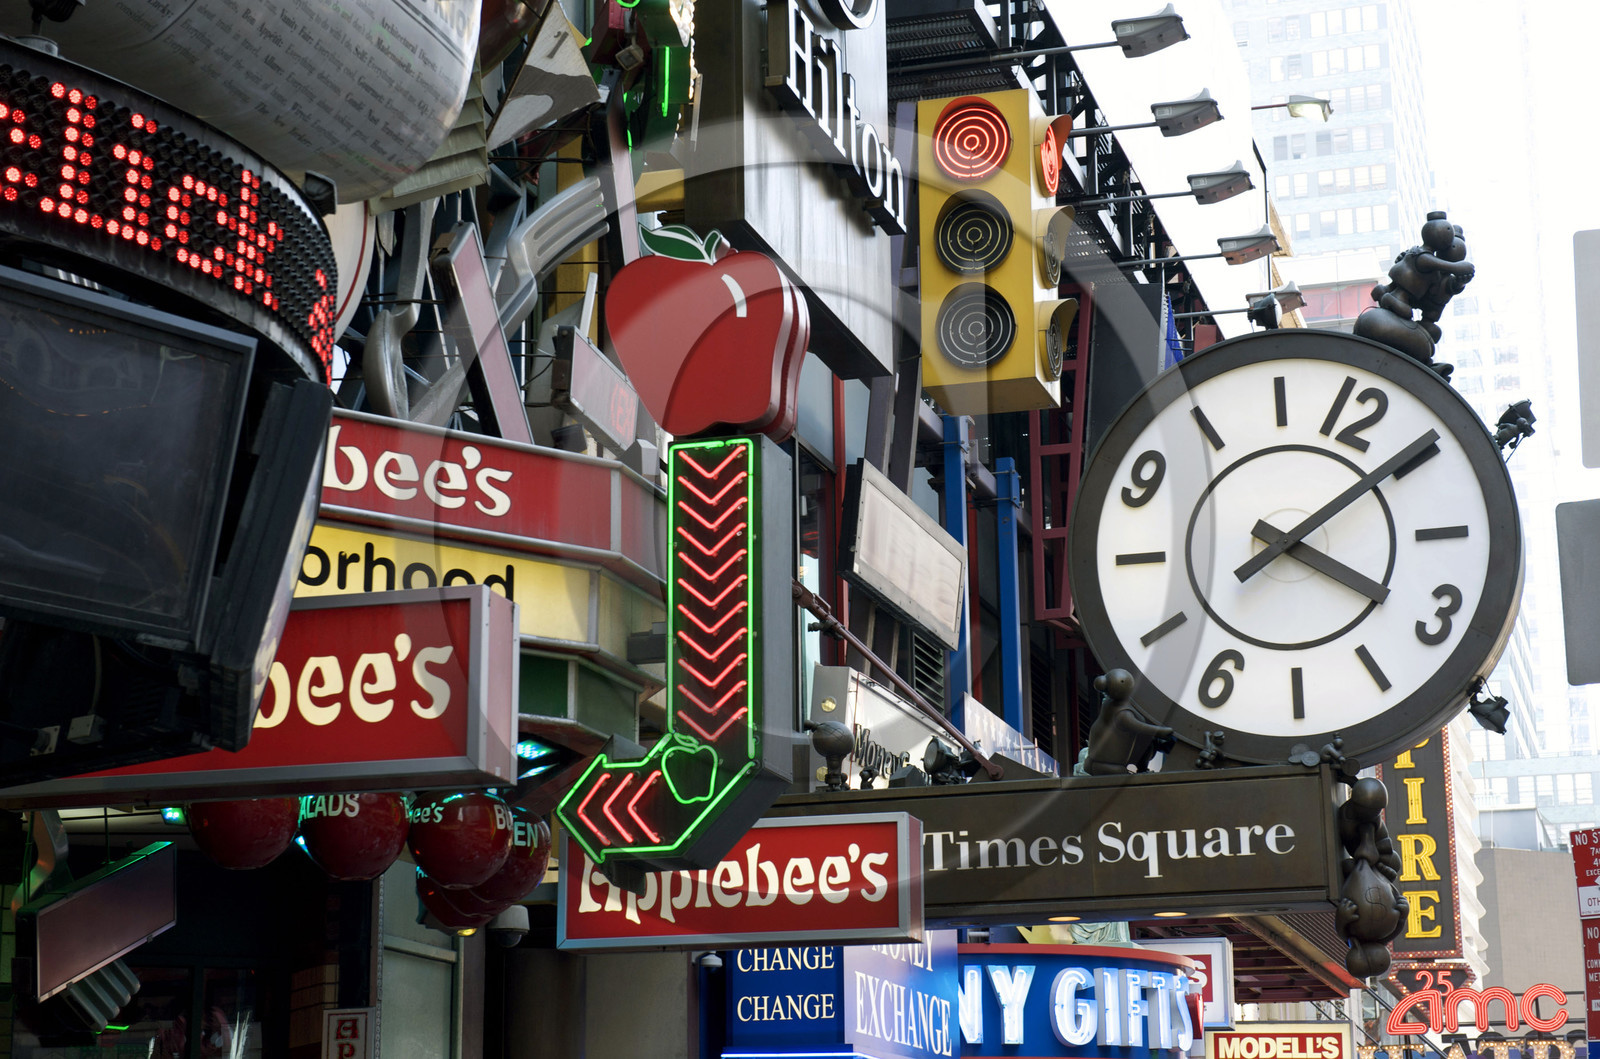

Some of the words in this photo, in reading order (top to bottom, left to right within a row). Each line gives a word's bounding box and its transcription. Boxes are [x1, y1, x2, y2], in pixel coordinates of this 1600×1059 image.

[786, 0, 906, 234] Hilton
[0, 82, 284, 313] lick
[1320, 375, 1389, 453] 12
[1121, 450, 1167, 508] 9
[1415, 583, 1463, 646] 3
[1197, 649, 1245, 709] 6
[923, 830, 1085, 872] Times
[1098, 821, 1296, 879] Square
[1394, 738, 1442, 939] IRE
[1575, 833, 1588, 846] NO
[736, 947, 835, 973] CHANGE
[1587, 926, 1600, 939] NO
[736, 993, 836, 1022] CHANGE
[958, 965, 1037, 1045] NY
[1049, 967, 1192, 1052] GIFTS
[1415, 970, 1455, 996] 25
[854, 970, 953, 1057] EXCHANGE
[1218, 1036, 1340, 1059] MODELL'S
